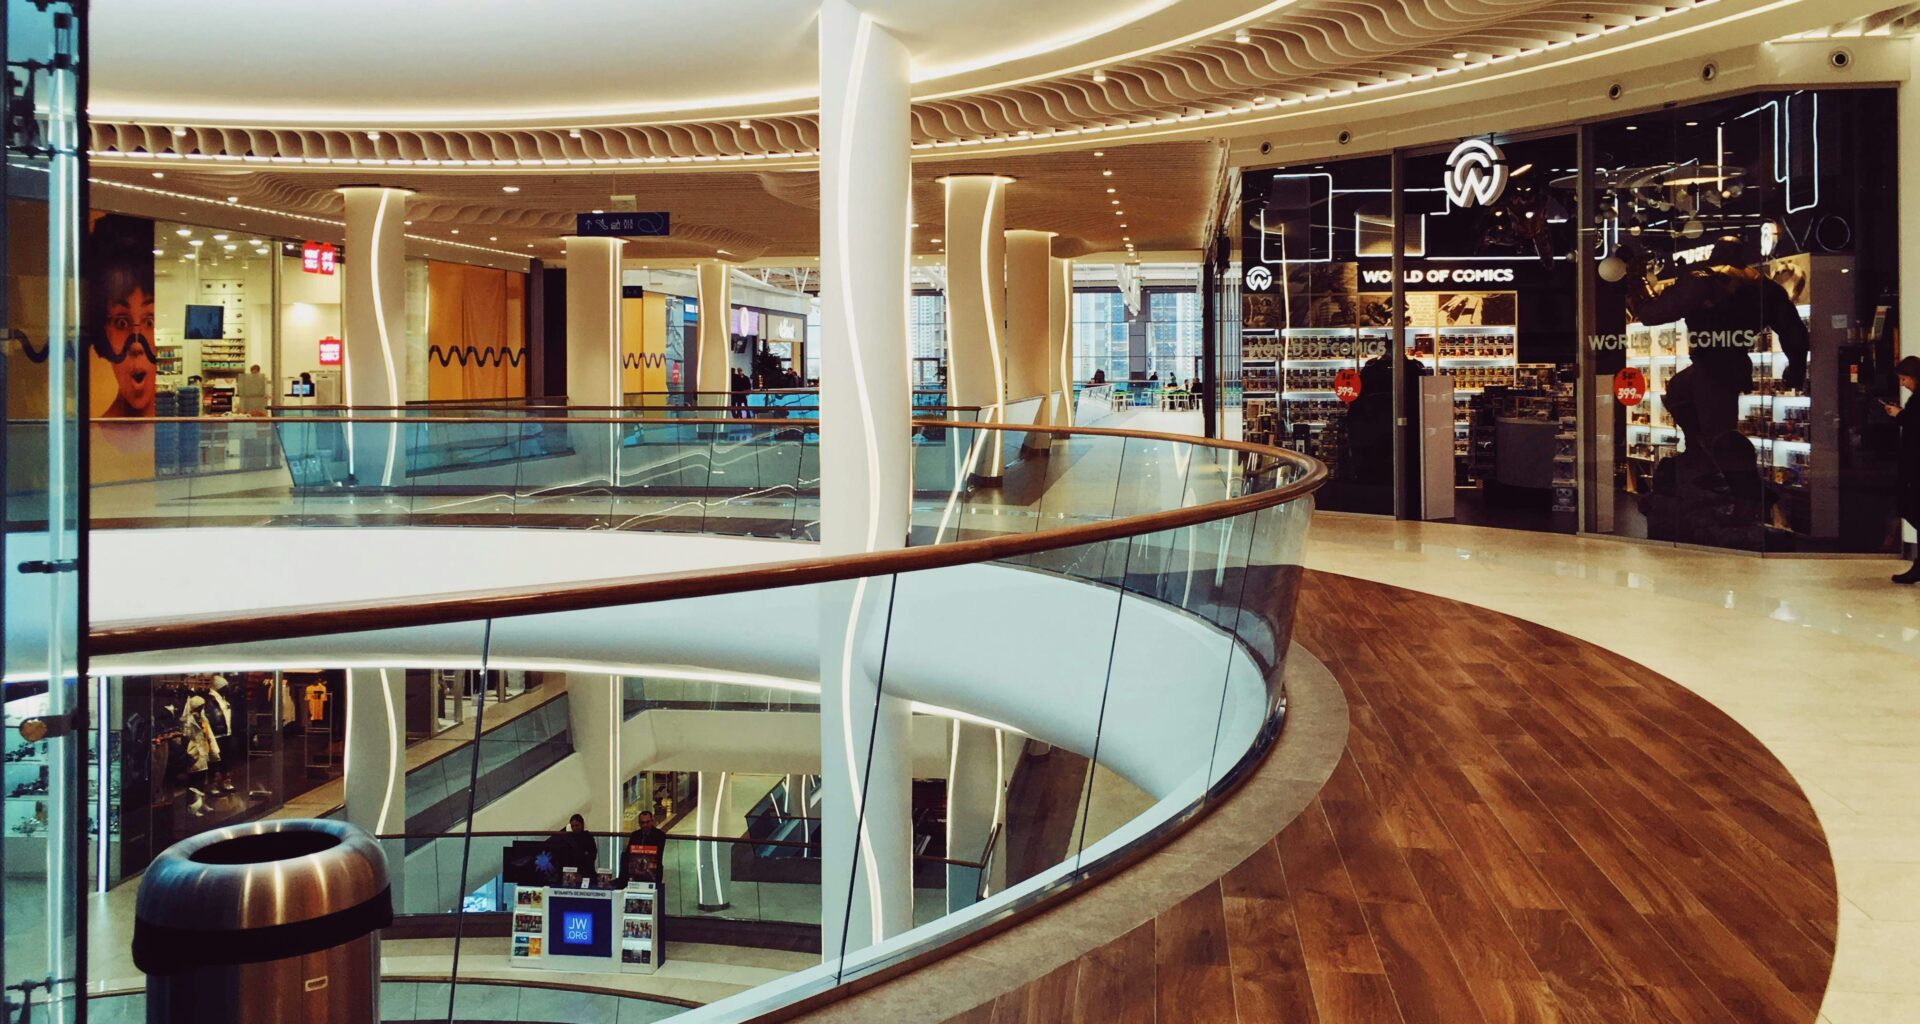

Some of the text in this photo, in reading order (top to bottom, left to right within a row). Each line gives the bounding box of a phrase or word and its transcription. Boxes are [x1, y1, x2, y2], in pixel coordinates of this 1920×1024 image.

[1363, 268, 1514, 284] WOLD OF COMICS
[1588, 329, 1756, 351] WORLD OF COMICS
[1248, 341, 1387, 358] WORLD OF COMICS
[569, 917, 587, 930] JW
[567, 931, 588, 941] .ORG
